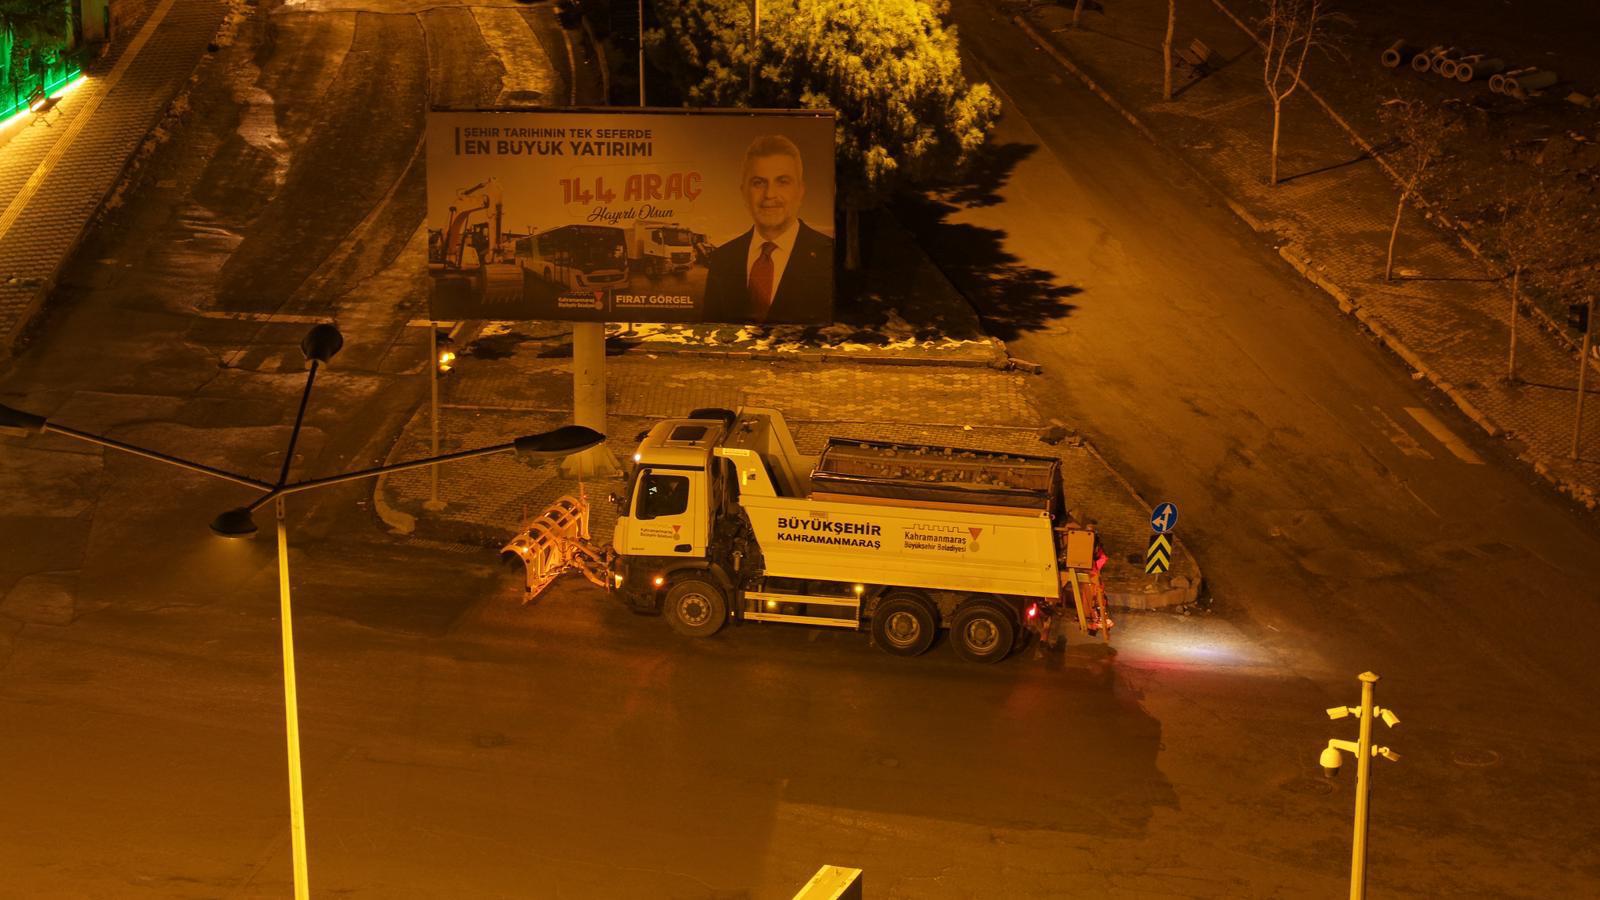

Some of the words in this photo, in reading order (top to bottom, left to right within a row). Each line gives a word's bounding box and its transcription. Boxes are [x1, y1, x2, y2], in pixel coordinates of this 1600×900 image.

[464, 127, 499, 138] ŞEHİR
[503, 127, 566, 138] TARİHİNİN
[569, 128, 593, 138] TEK
[596, 129, 651, 139] SEFERDE
[464, 140, 490, 155] EN
[497, 140, 564, 155] BÜYÜK
[570, 141, 652, 157] YATIRIMI
[559, 177, 616, 205] 144
[623, 172, 703, 202] ARAÇ
[587, 206, 637, 225] Hayırlı
[638, 204, 673, 220] Olsun
[616, 295, 647, 304] FIRAT
[649, 295, 694, 304] GÖRGEL
[777, 516, 881, 536] BÜYÜKŞEHİR
[777, 532, 881, 550] KAHRAMANMARAŞ
[904, 531, 967, 545] Kahramanmaraş
[937, 544, 967, 553] Belediyesi
